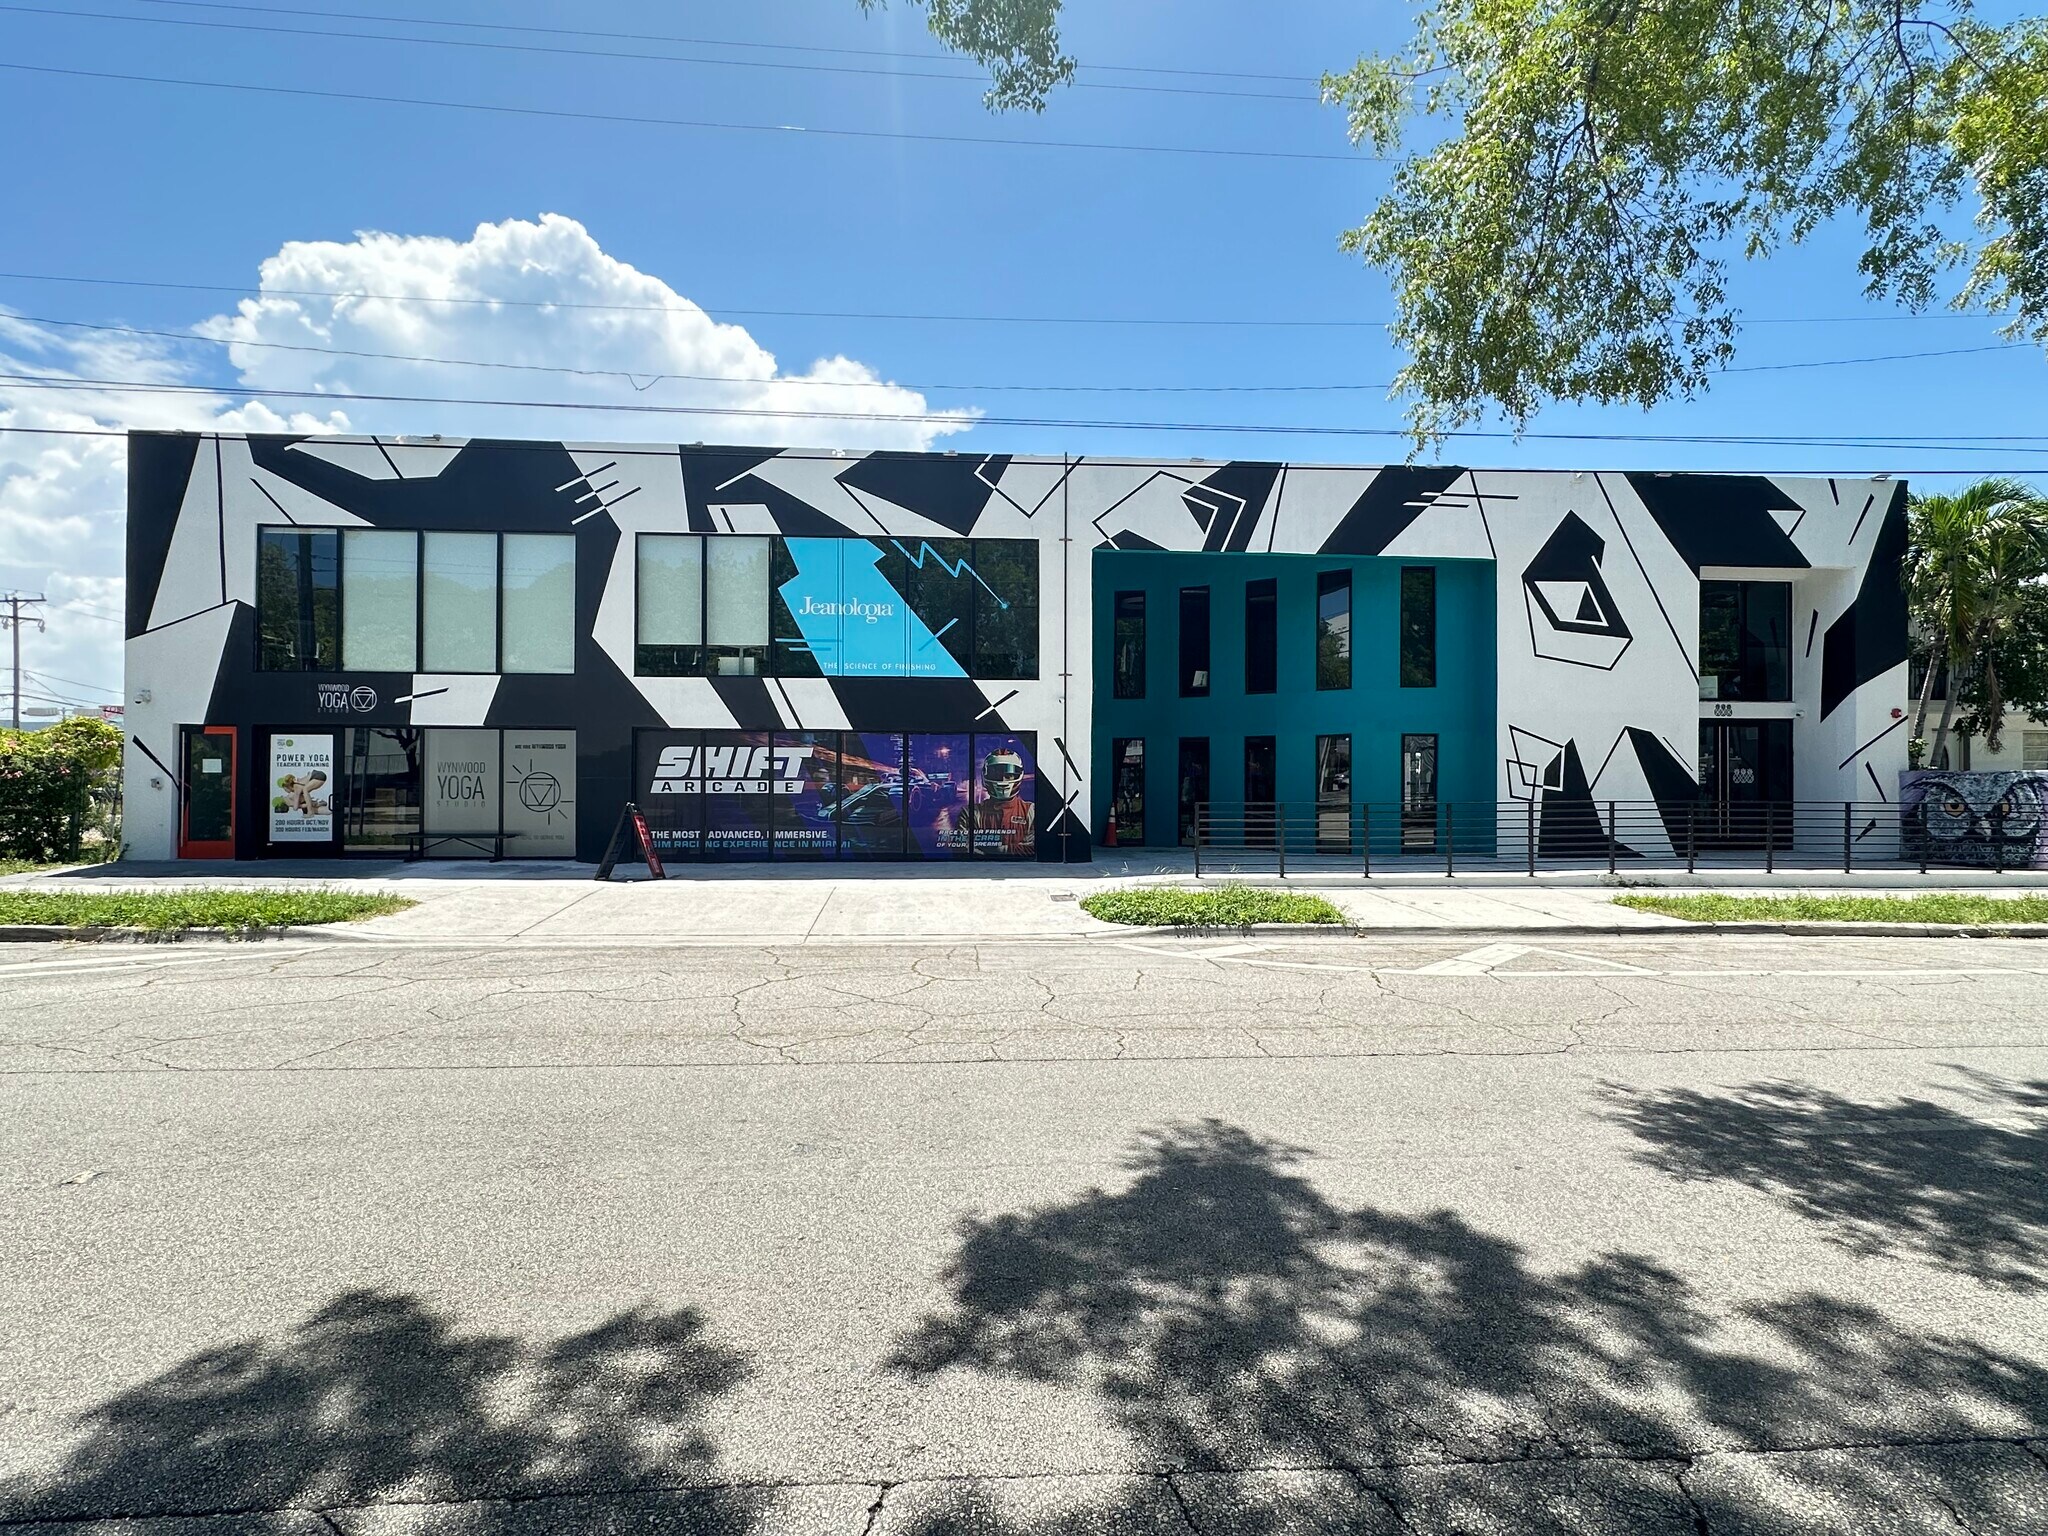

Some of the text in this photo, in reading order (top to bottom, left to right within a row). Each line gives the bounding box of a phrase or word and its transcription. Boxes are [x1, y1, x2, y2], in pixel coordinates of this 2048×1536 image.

[799, 596, 894, 624] Jeanologia
[844, 662, 877, 670] SCIENCE
[895, 663, 936, 671] FINISHING
[318, 684, 350, 692] WYNWOOD
[318, 692, 349, 709] YOGA
[276, 753, 330, 762] POWER YOGA
[655, 746, 814, 778] SHIFT
[437, 761, 486, 774] WYNWOOD
[437, 775, 485, 800] YOGA
[660, 781, 794, 792] ARCADE
[651, 830, 828, 840] THE MOST ADVANCED, IMMERSIVE
[674, 840, 720, 848] RACING
[722, 840, 796, 848] EXPERIENCE
[798, 840, 810, 848] IN
[811, 840, 851, 848] MIAMI
